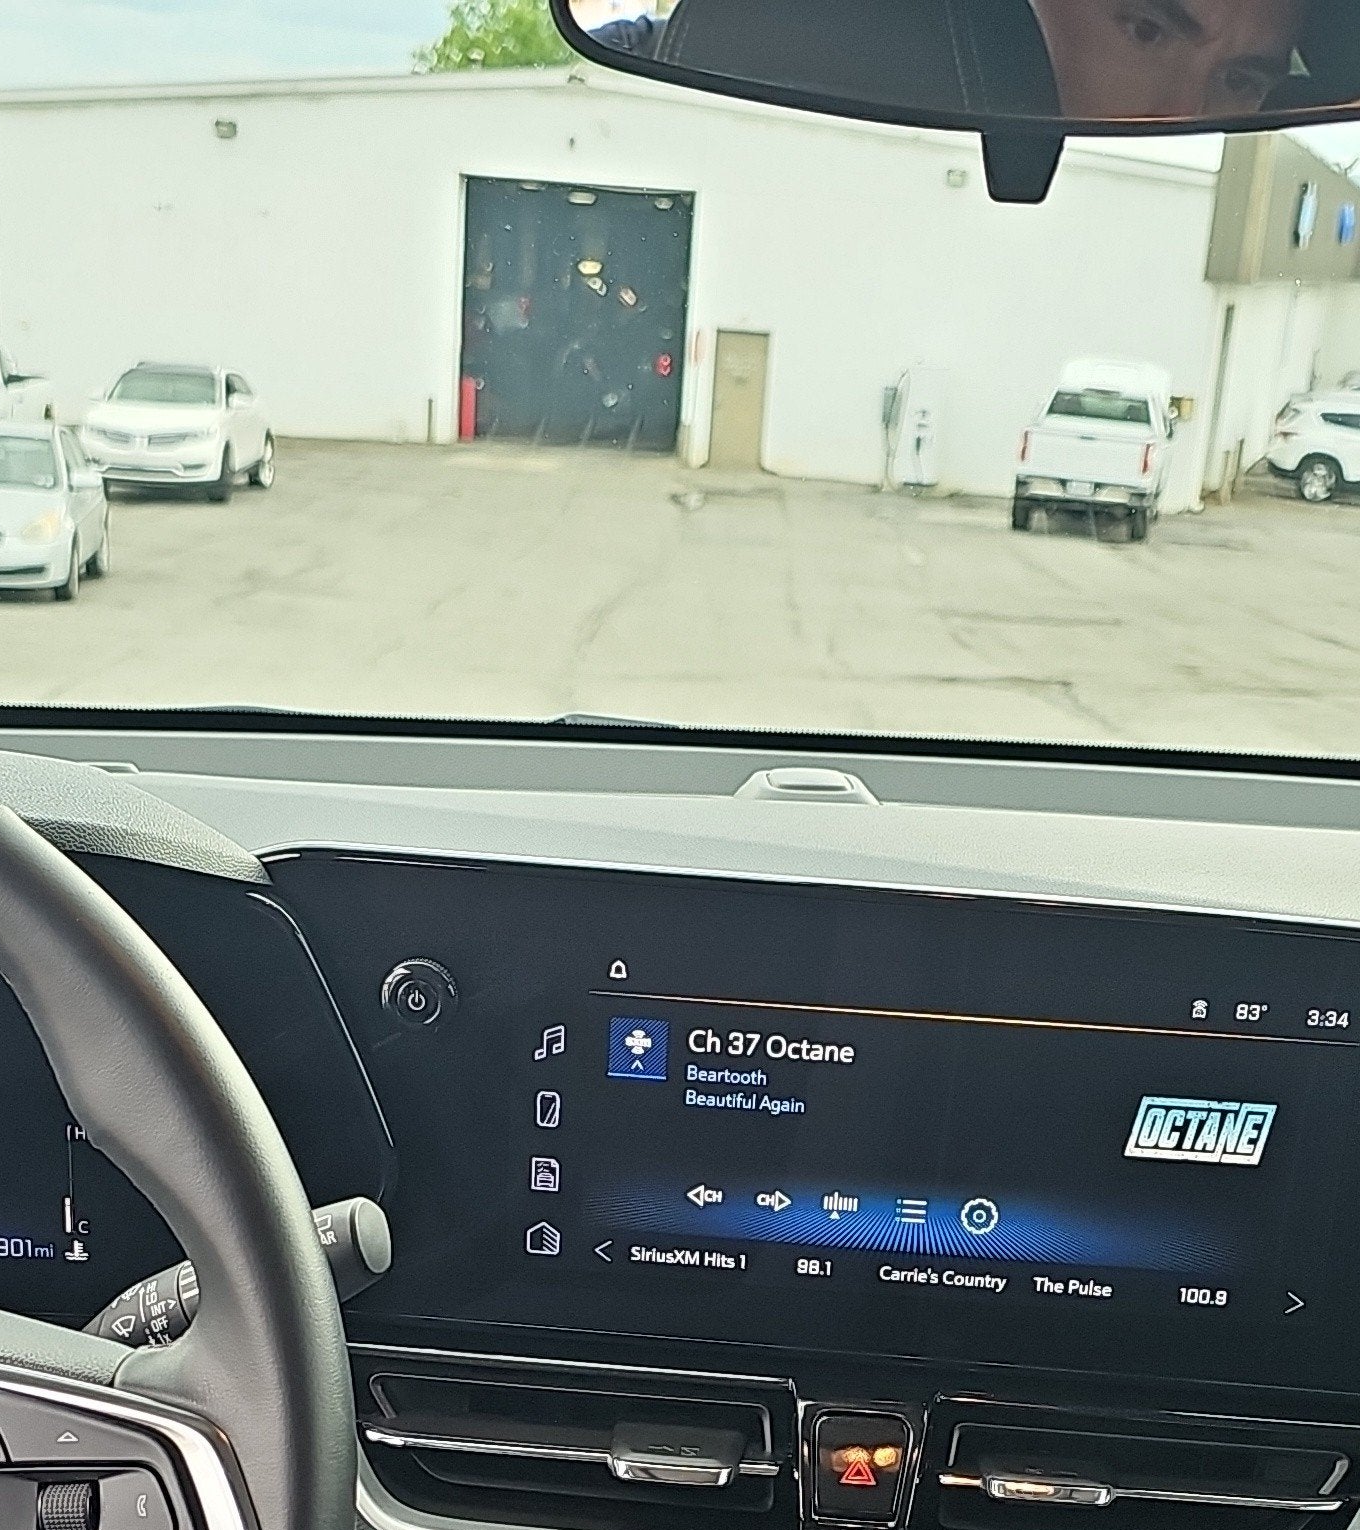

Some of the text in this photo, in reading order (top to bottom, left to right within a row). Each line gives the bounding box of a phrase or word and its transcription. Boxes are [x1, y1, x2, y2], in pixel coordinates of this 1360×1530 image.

[1236, 1004, 1268, 1021] 83°
[1307, 1009, 1349, 1028] 3:34
[688, 1029, 855, 1063] Ch 37 Octane
[686, 1065, 767, 1085] Beartooth
[685, 1089, 805, 1114] Beautiful Again
[74, 1126, 86, 1140] H
[1138, 1108, 1264, 1154] OCTANE
[705, 1189, 722, 1203] CH
[757, 1193, 775, 1207] CH
[78, 1220, 89, 1234] C
[630, 1246, 700, 1266] SiriusXM
[704, 1252, 735, 1268] Hits
[797, 1258, 832, 1276] 98.1
[879, 1265, 1007, 1292] Carrie's Country
[1033, 1276, 1112, 1297] The Pulse
[150, 1314, 169, 1333] OFF
